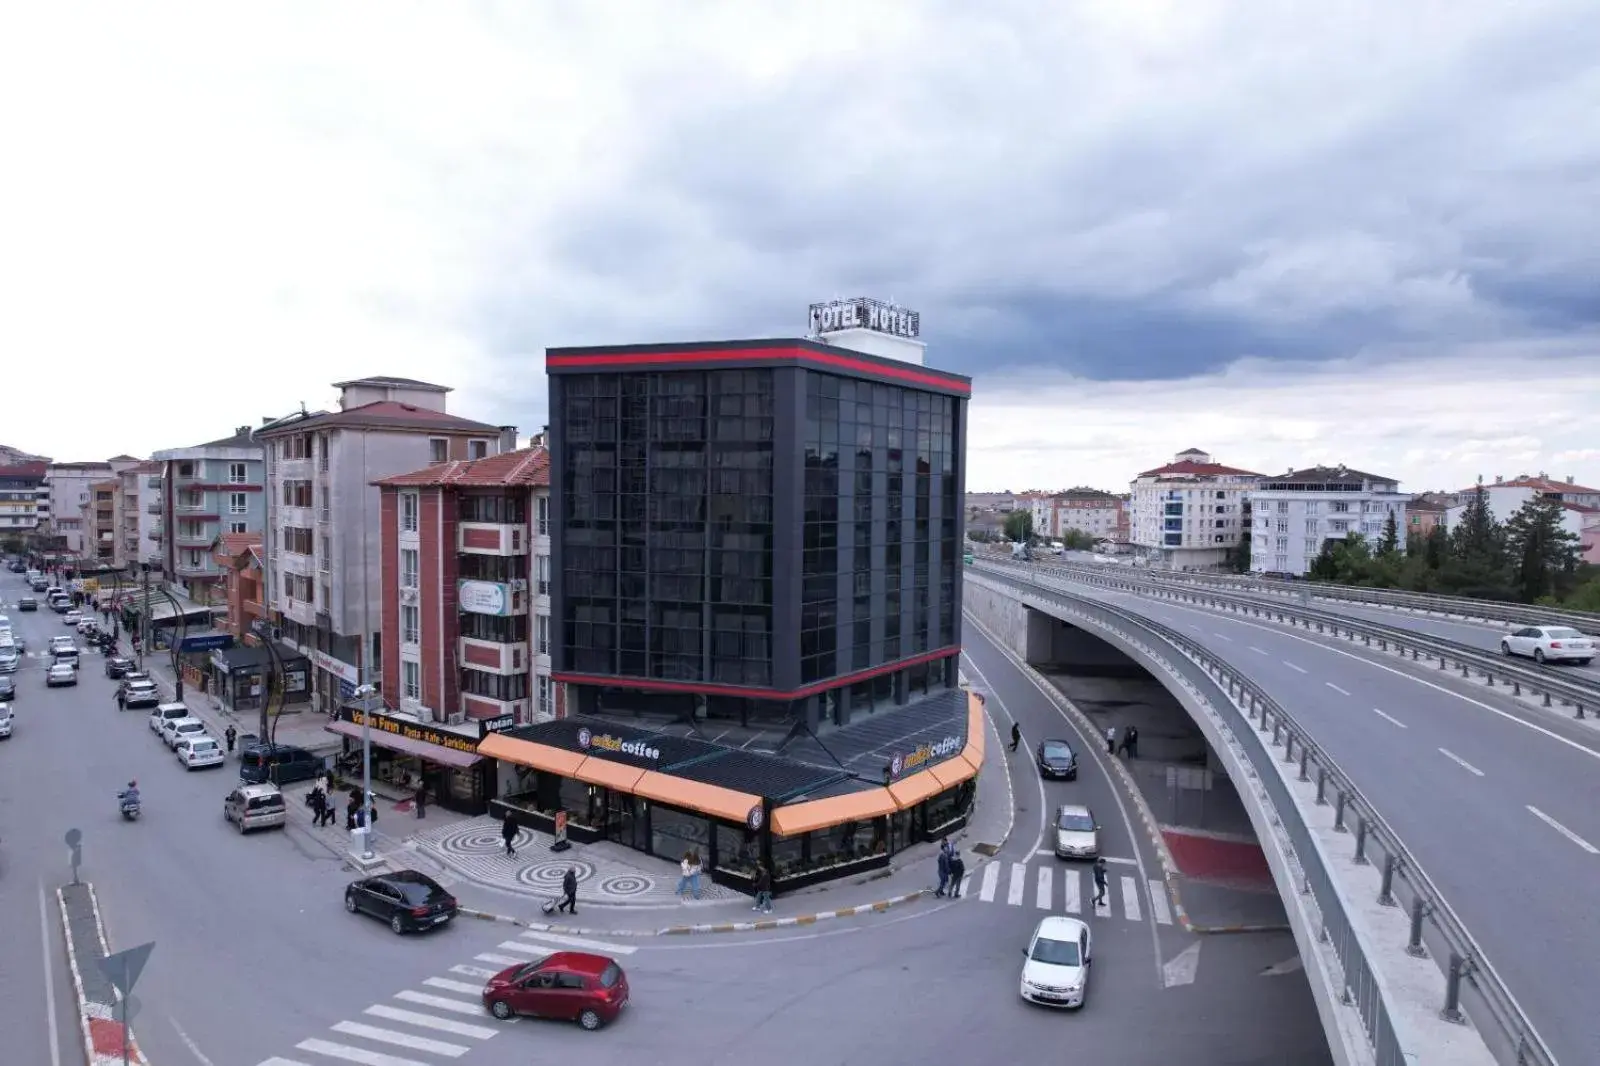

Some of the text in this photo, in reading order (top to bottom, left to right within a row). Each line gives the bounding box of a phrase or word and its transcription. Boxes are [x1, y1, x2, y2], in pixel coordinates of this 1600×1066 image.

[869, 304, 915, 337] HOTEL
[485, 718, 513, 731] Vatan
[621, 742, 660, 759] coffee
[930, 736, 961, 757] coffee
